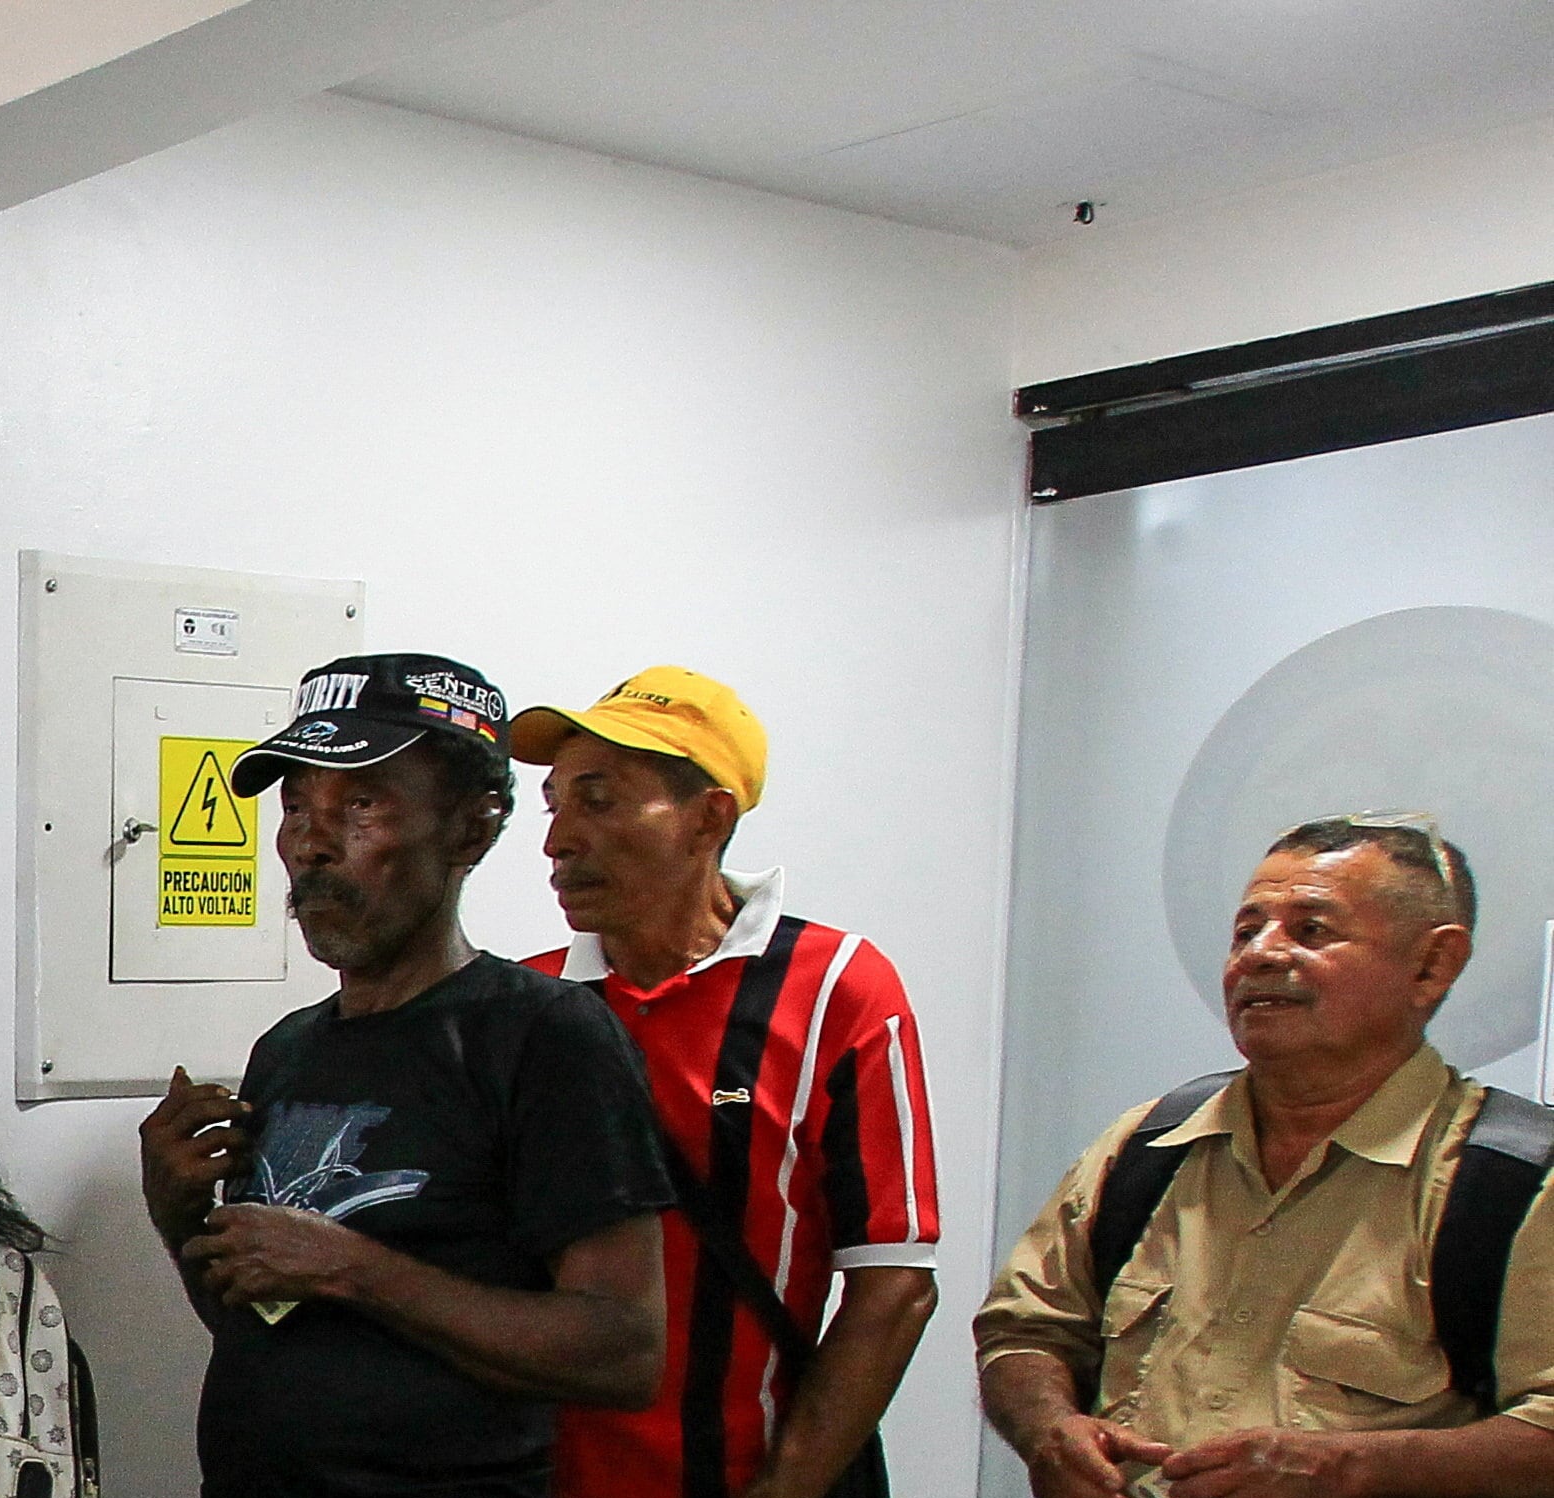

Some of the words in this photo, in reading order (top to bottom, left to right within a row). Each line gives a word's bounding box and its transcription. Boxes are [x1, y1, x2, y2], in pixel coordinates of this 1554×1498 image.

[163, 868, 253, 893] PRECAUCIÓN
[162, 896, 195, 915] ALTO
[198, 896, 253, 916] VOLTAJE
